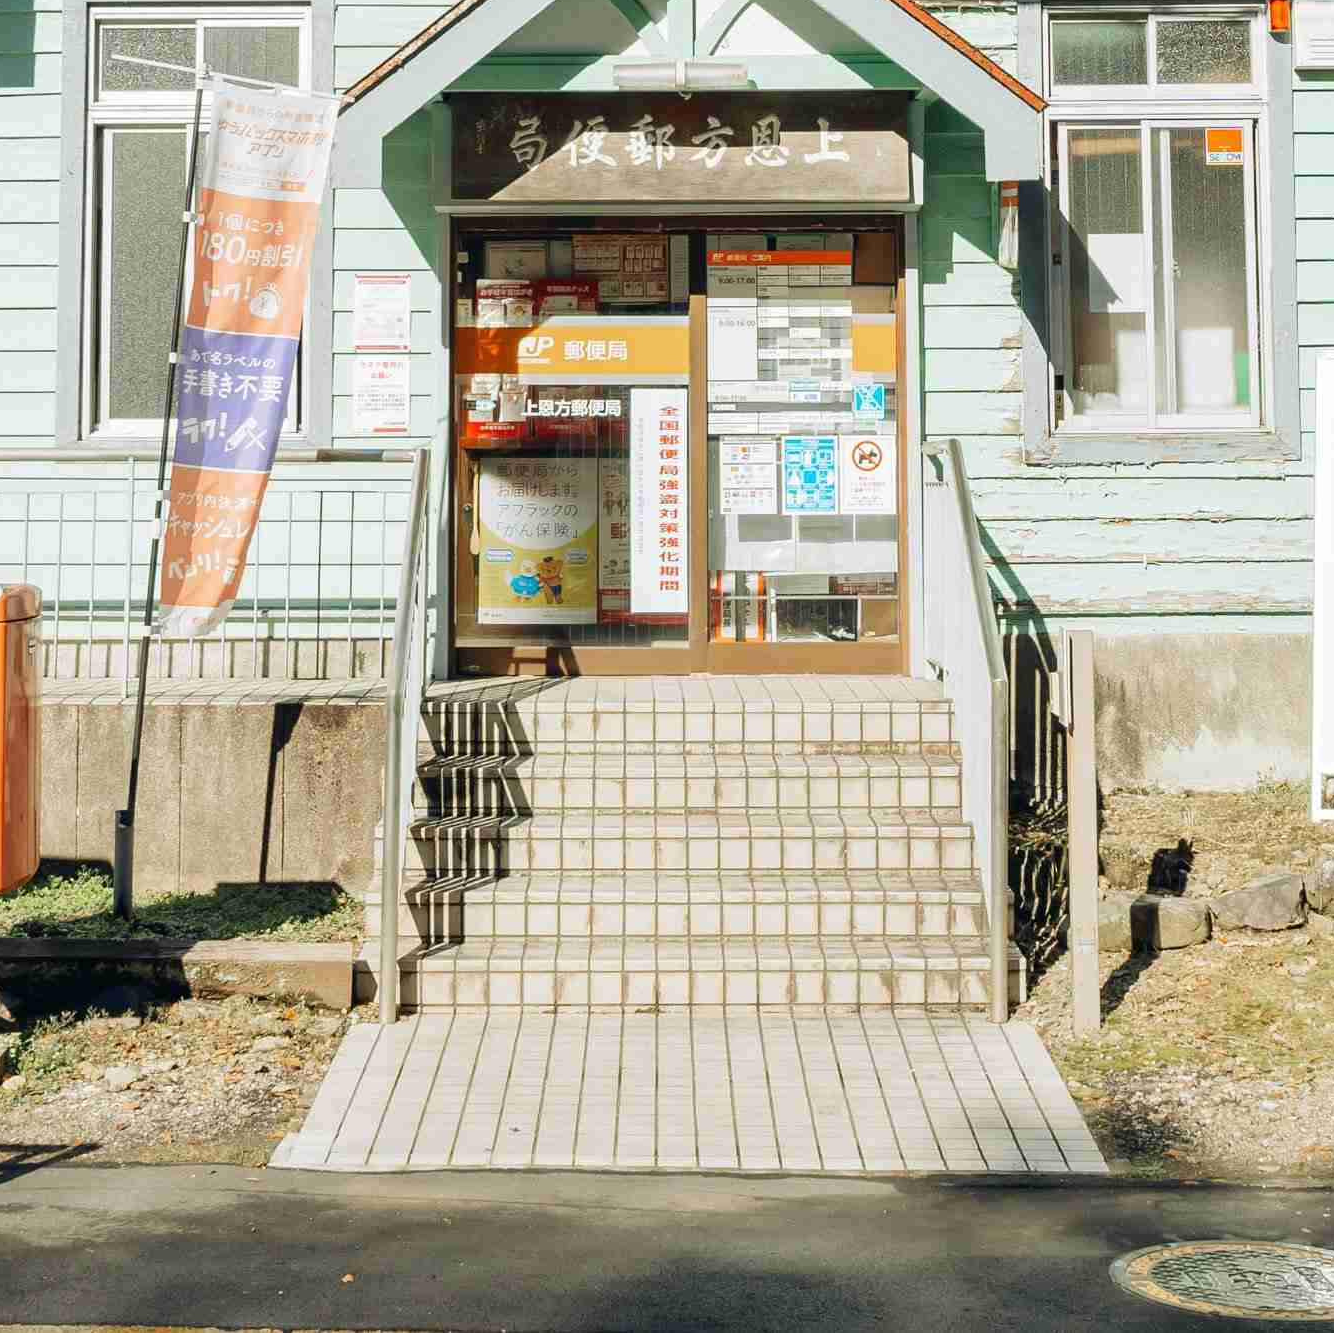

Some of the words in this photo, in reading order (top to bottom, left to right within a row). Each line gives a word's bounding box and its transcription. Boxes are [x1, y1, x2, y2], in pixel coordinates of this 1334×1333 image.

[203, 229, 304, 267] 180円割引
[190, 349, 276, 369] あて名ラベルの
[563, 339, 628, 361] 郵便局
[183, 368, 285, 403] 手書き不要
[521, 398, 622, 417] 上恩方郵便局
[498, 503, 579, 517] アフラックの
